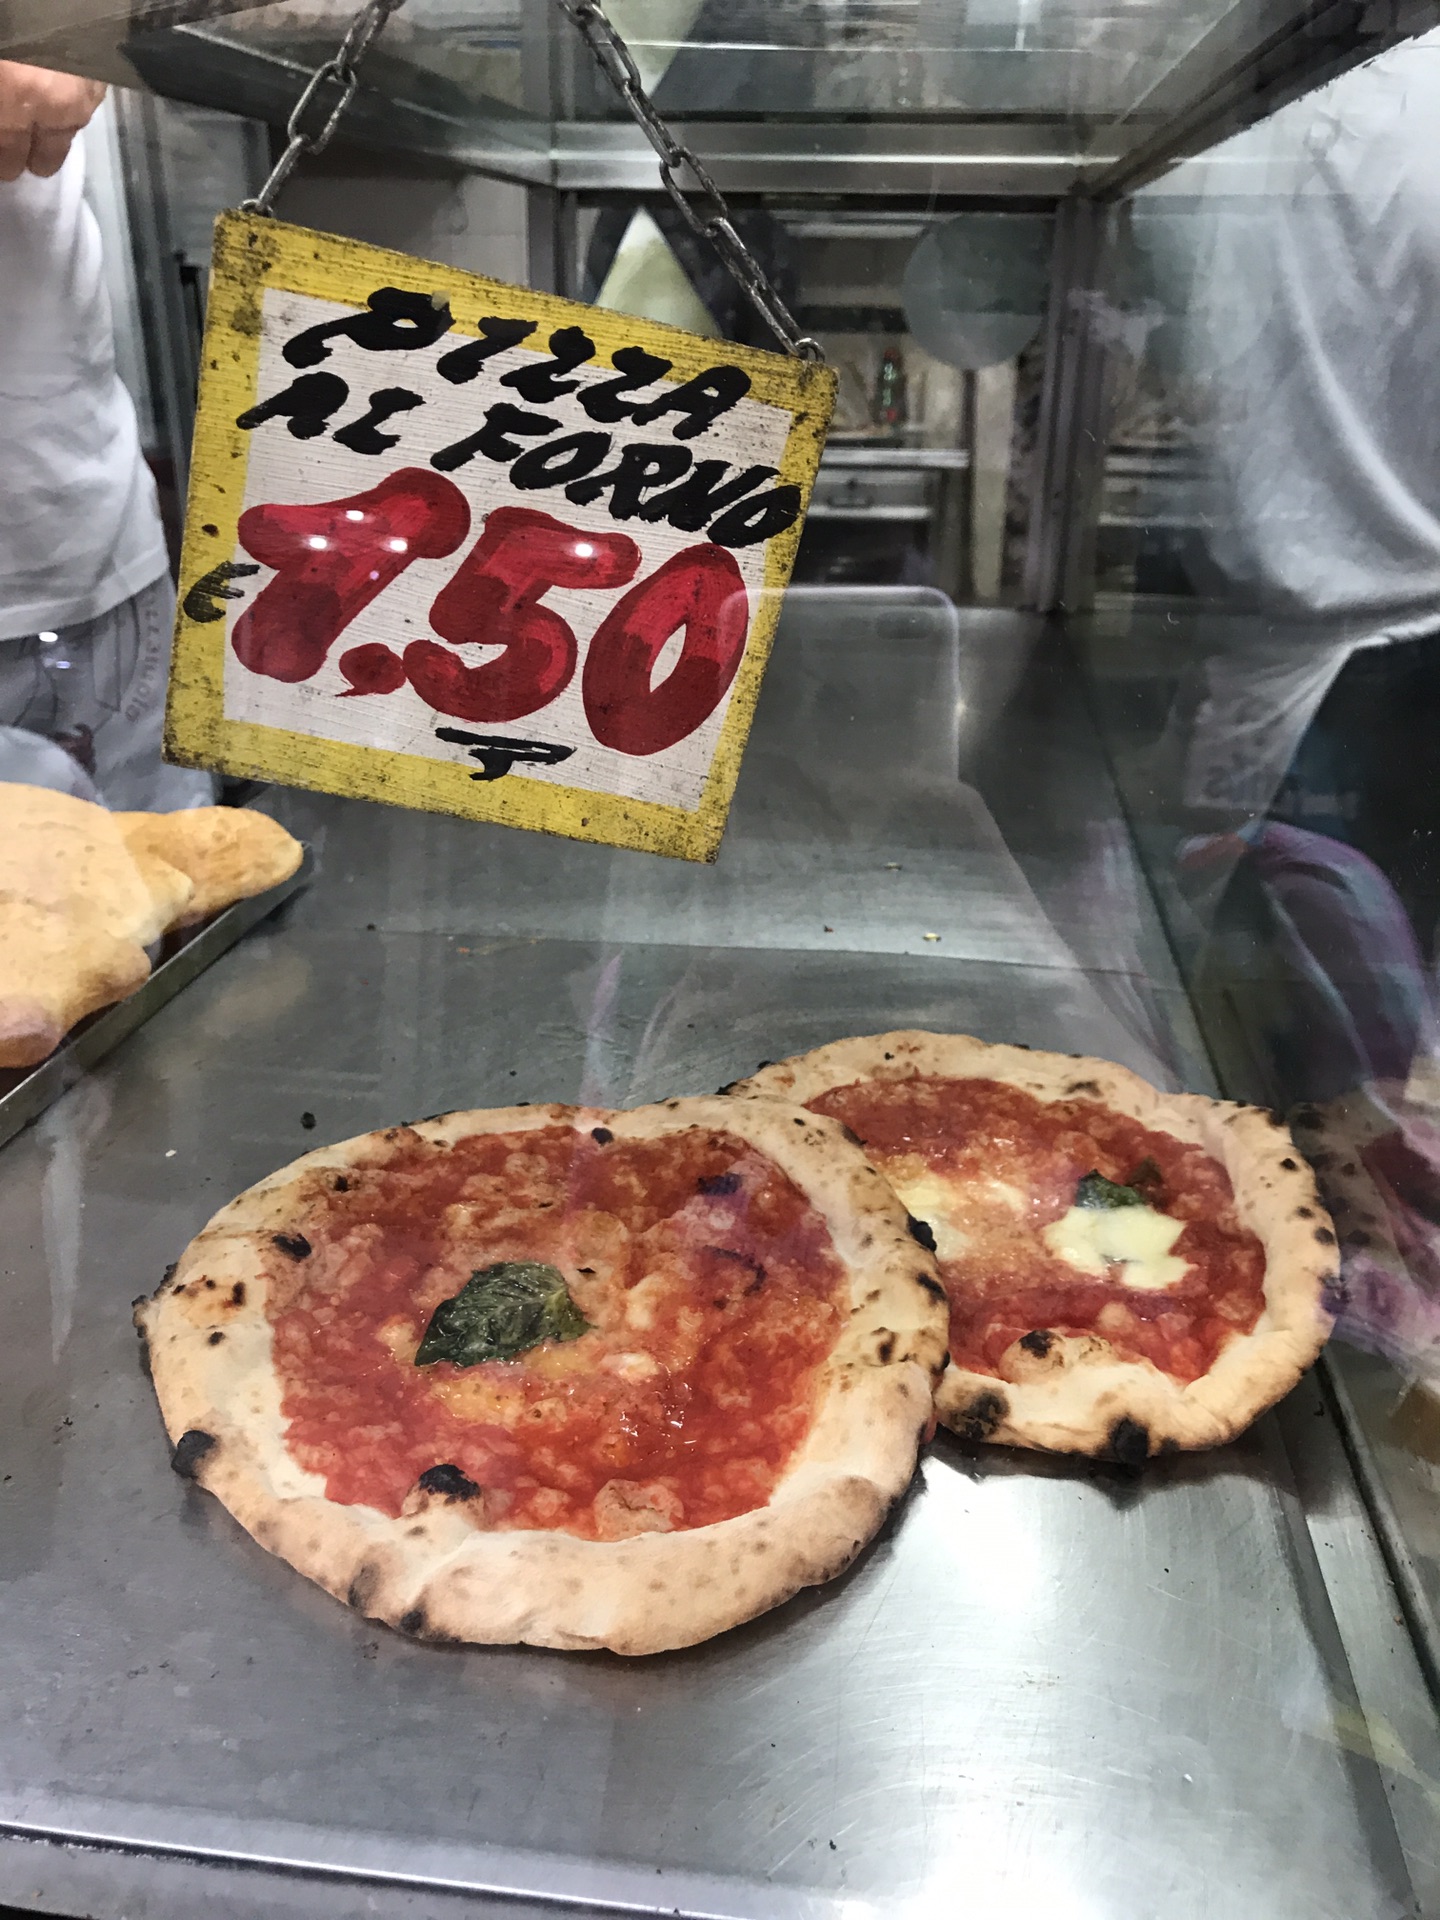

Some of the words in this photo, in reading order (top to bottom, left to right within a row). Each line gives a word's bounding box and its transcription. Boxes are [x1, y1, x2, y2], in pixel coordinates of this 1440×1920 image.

[282, 287, 751, 440] PIZZA
[236, 371, 426, 455] AL
[430, 403, 801, 549] FORNO
